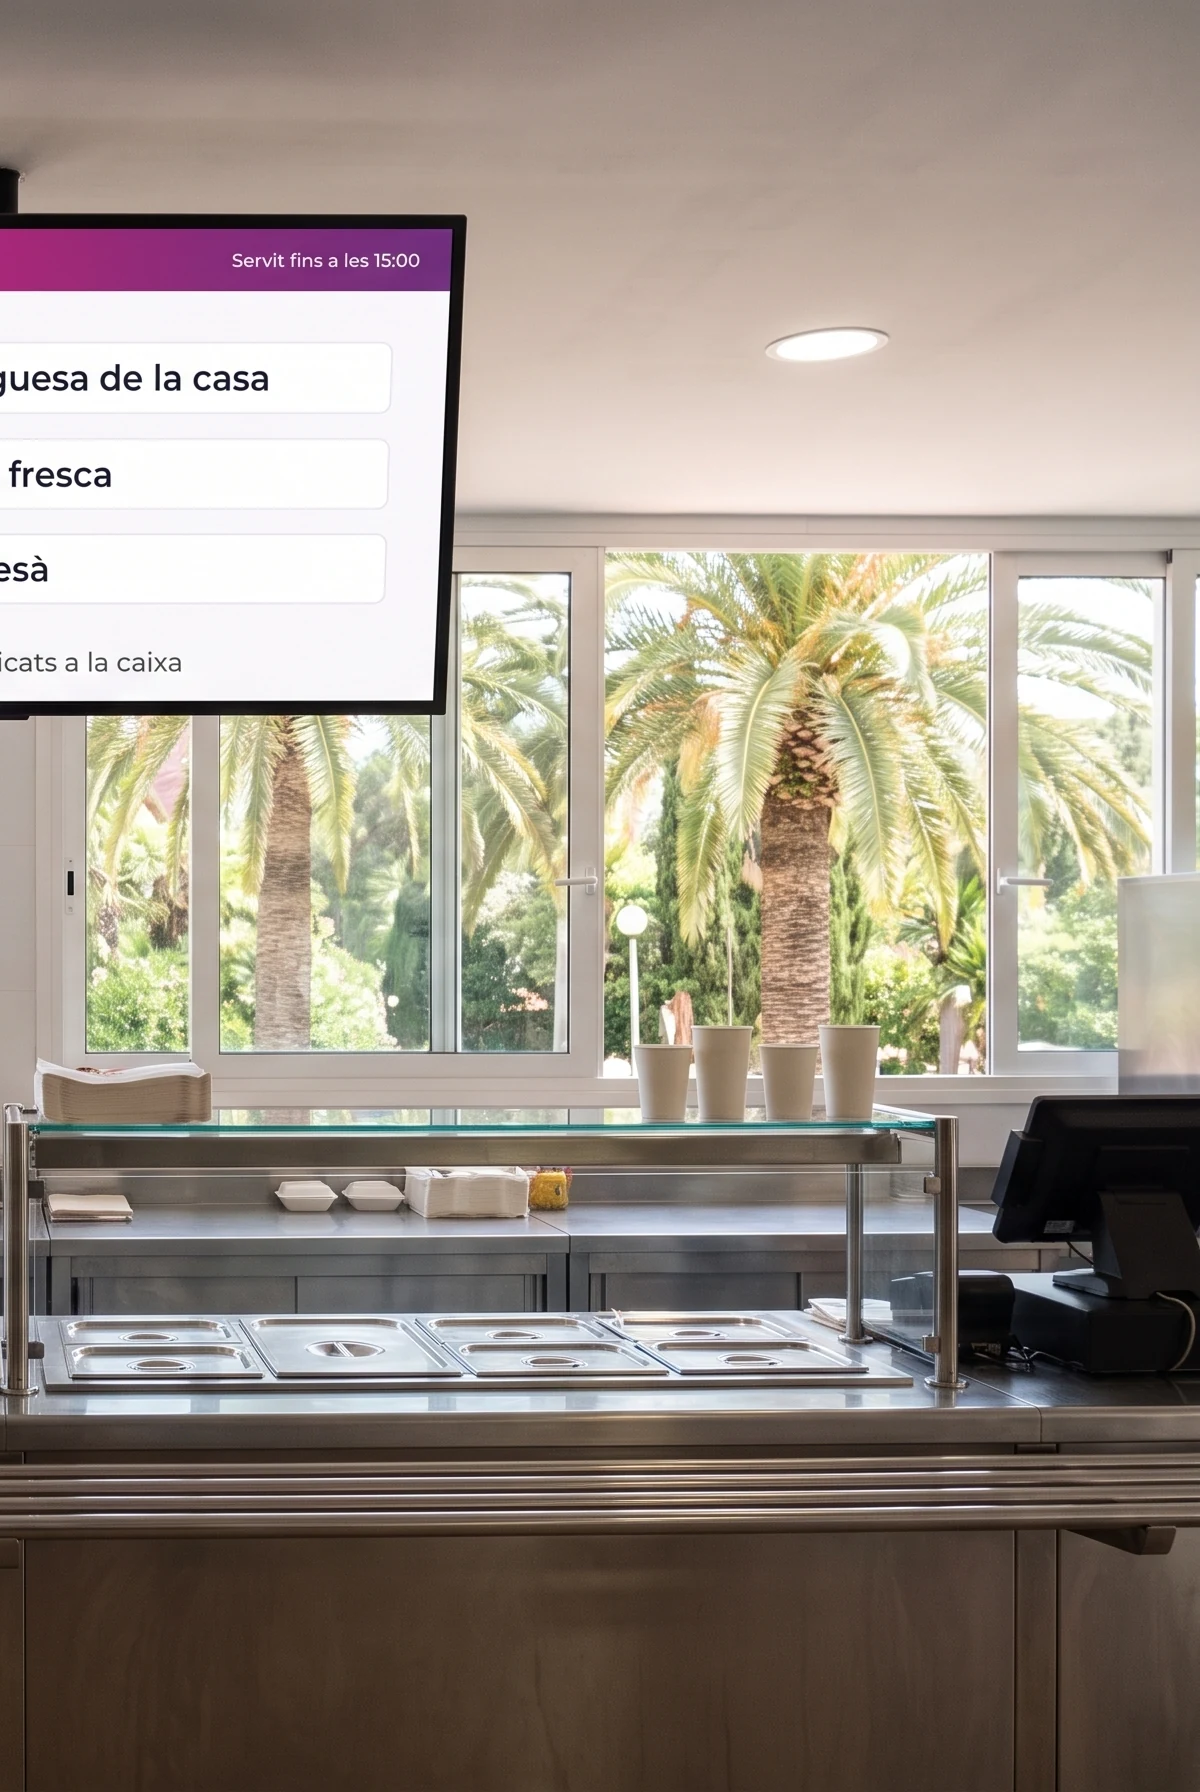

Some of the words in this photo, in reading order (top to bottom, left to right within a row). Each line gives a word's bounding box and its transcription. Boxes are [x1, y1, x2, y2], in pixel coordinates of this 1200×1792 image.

[232, 252, 285, 268] Servit
[290, 252, 323, 268] fins
[328, 256, 338, 268] a
[344, 252, 369, 268] les
[373, 253, 420, 268] 15:00
[100, 363, 142, 392] de
[155, 363, 182, 392] la
[193, 370, 269, 392] casa
[9, 459, 112, 488] fresca
[65, 656, 79, 673] a
[88, 651, 108, 673] la
[116, 650, 182, 673] caixa
